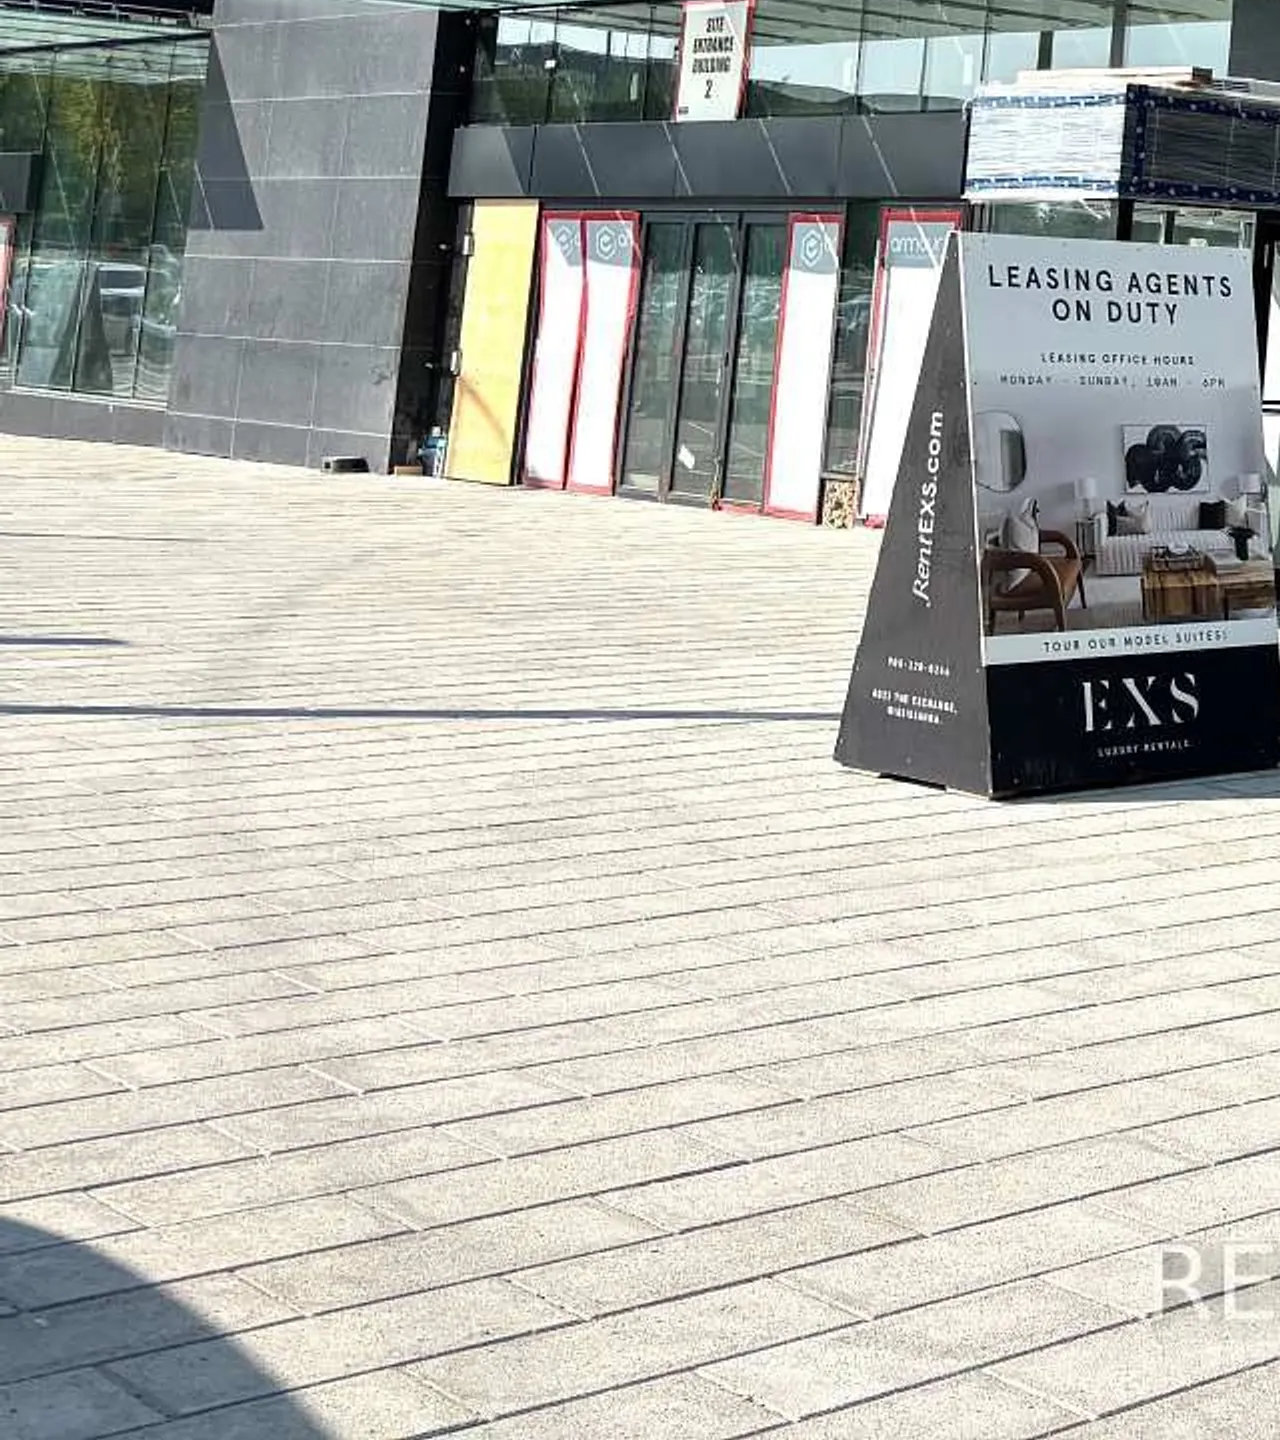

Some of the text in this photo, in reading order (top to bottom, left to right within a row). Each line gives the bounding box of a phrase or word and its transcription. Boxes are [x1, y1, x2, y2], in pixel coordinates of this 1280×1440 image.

[704, 79, 713, 98] 2
[988, 264, 1232, 297] LEASING AGENTS
[1052, 298, 1178, 325] ON DUTY
[1041, 352, 1194, 365] LEASING OFFICE HOURS
[913, 411, 944, 607] RentEXS.com
[1043, 641, 1080, 653] TOUR
[1088, 638, 1116, 650] OUR
[1124, 634, 1169, 647] MODEL
[1082, 672, 1200, 732] EXS
